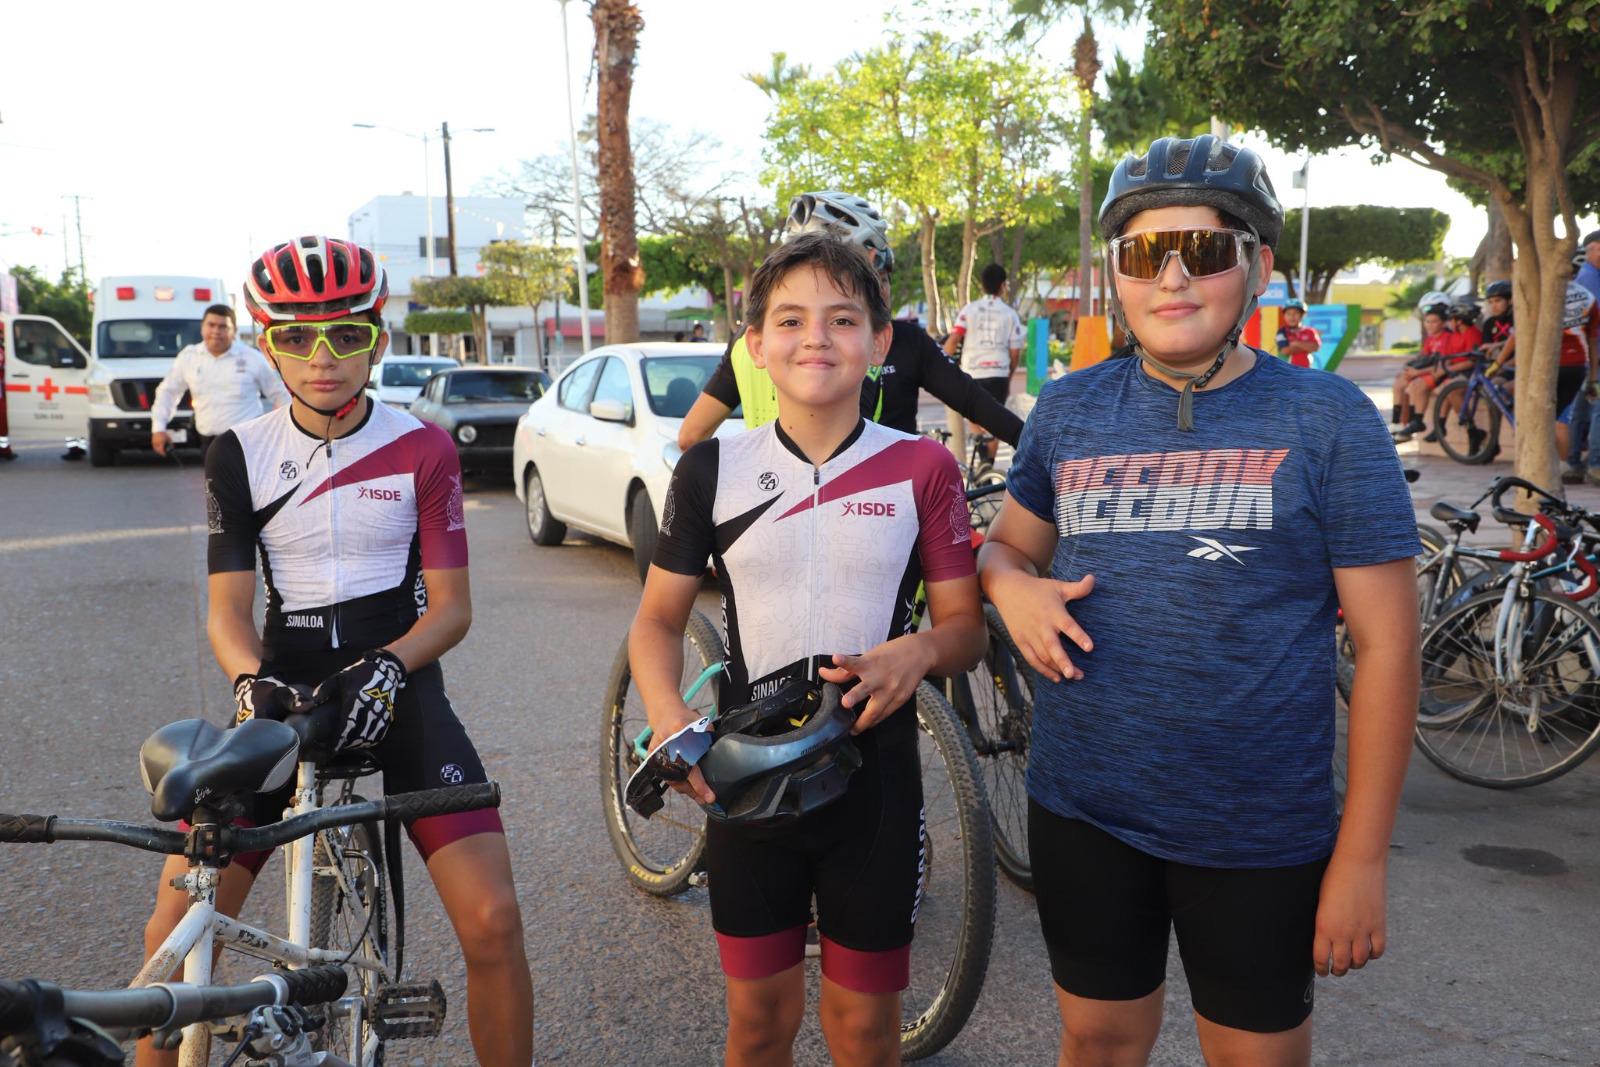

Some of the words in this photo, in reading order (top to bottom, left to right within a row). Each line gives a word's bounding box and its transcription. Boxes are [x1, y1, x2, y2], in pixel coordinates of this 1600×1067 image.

[369, 488, 401, 501] ISDE
[858, 503, 896, 516] ISDE
[286, 615, 324, 628] SINALOA
